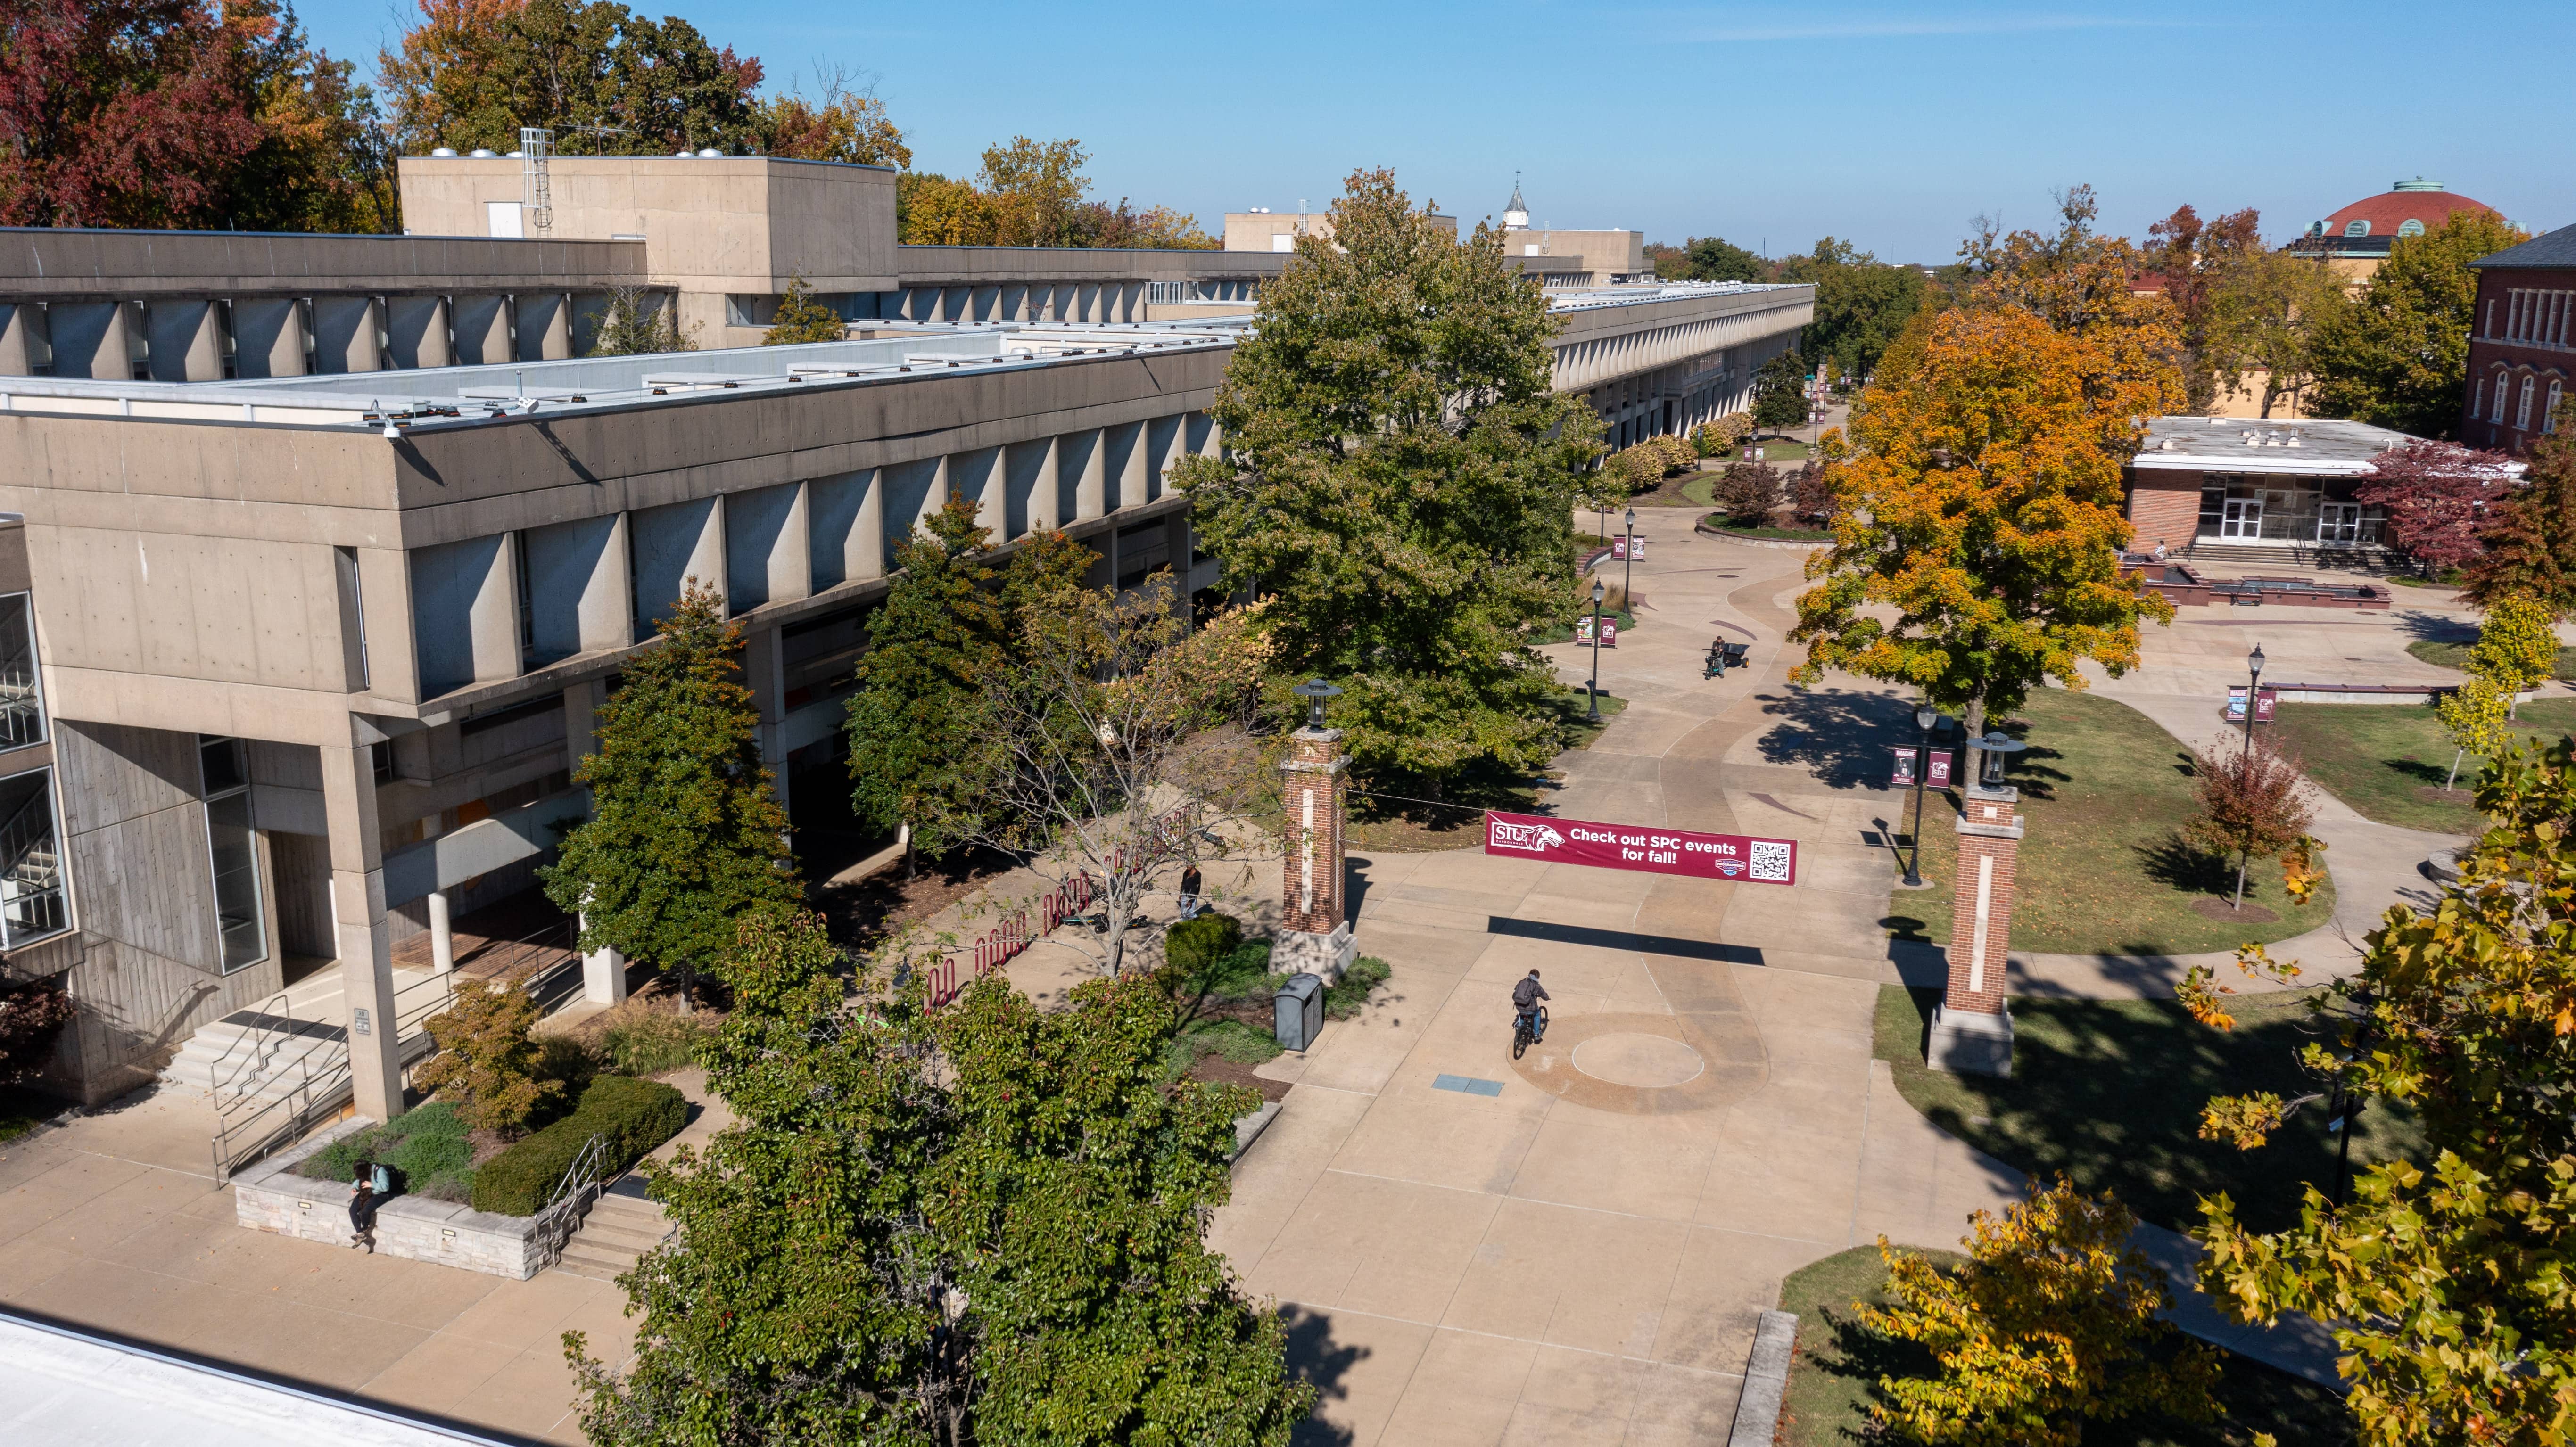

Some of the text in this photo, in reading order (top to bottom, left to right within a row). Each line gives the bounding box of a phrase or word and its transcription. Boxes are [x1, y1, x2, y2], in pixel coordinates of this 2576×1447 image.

[1495, 826, 1526, 841] SIU
[1570, 828, 1736, 855] Check out SPC events
[1622, 847, 1676, 864] for fall!
